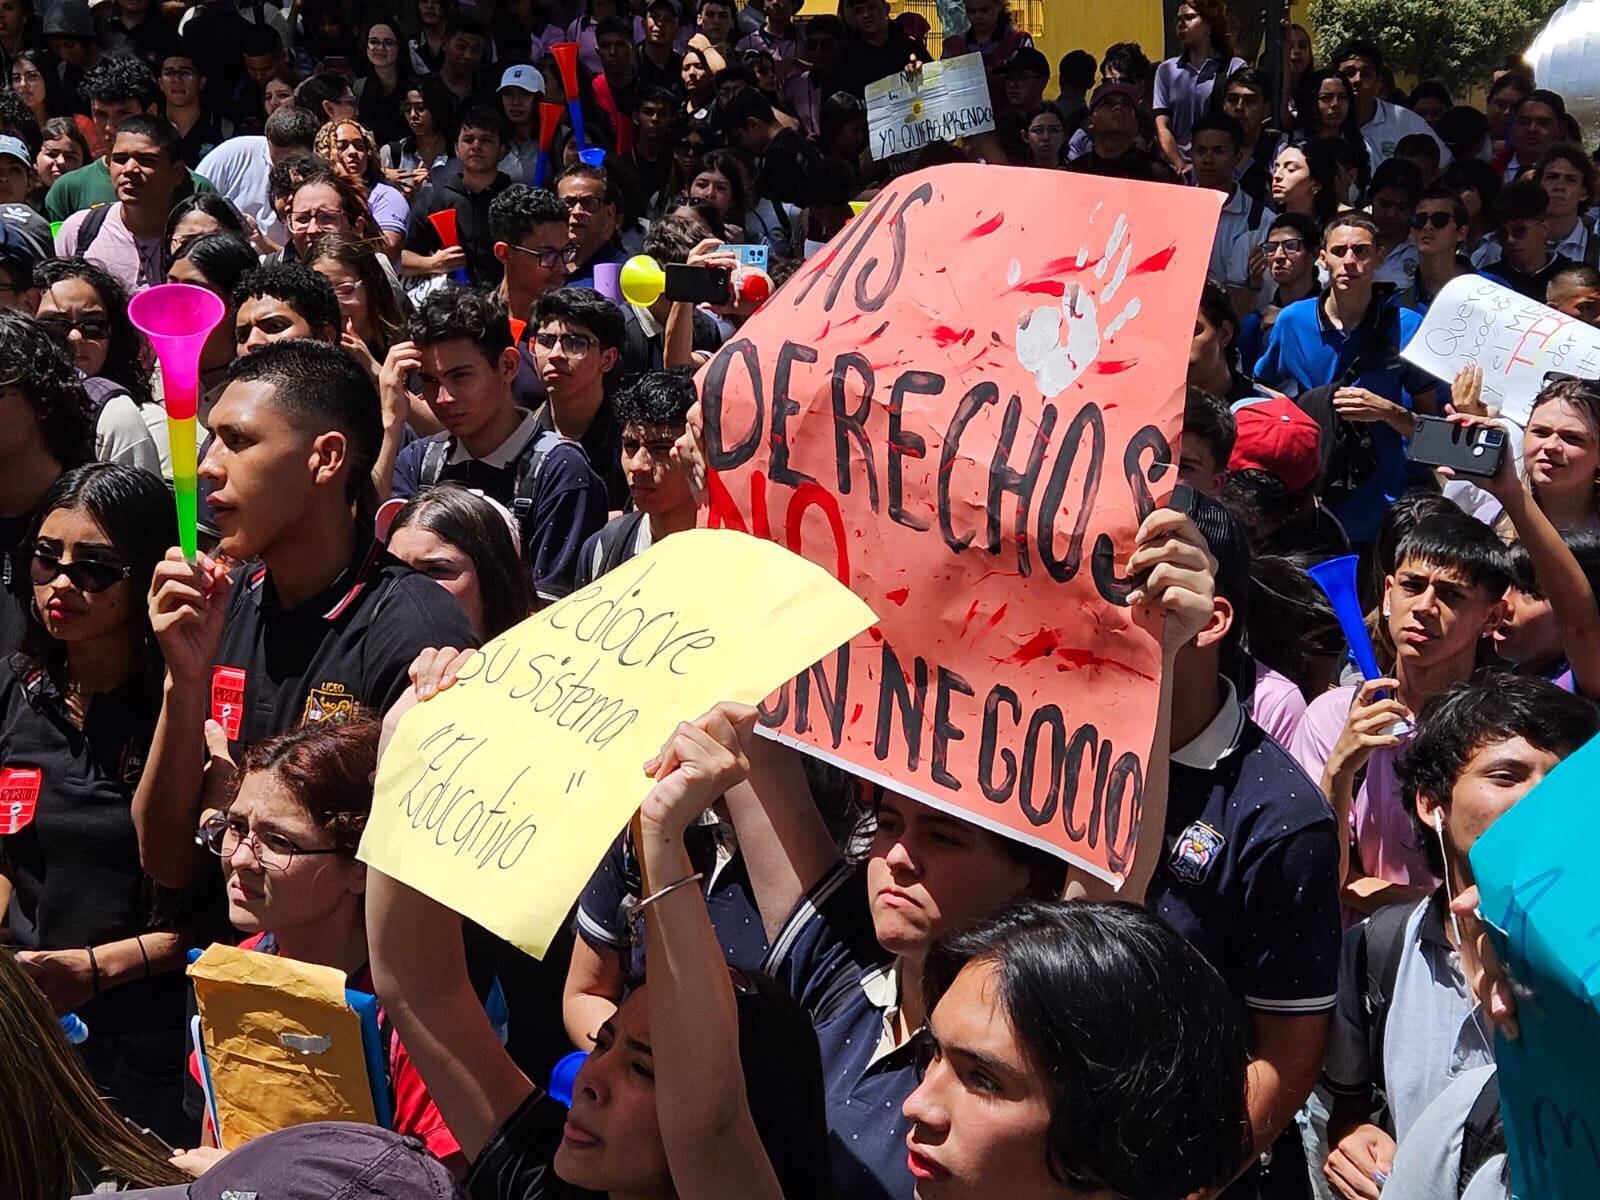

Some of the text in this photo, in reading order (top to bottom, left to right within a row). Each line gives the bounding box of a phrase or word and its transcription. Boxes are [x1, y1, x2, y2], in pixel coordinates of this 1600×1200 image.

[879, 128, 896, 159] YO
[702, 338, 1172, 607] DERECHOS
[546, 562, 715, 674] ediocre
[874, 640, 1143, 873] NEGOCIO
